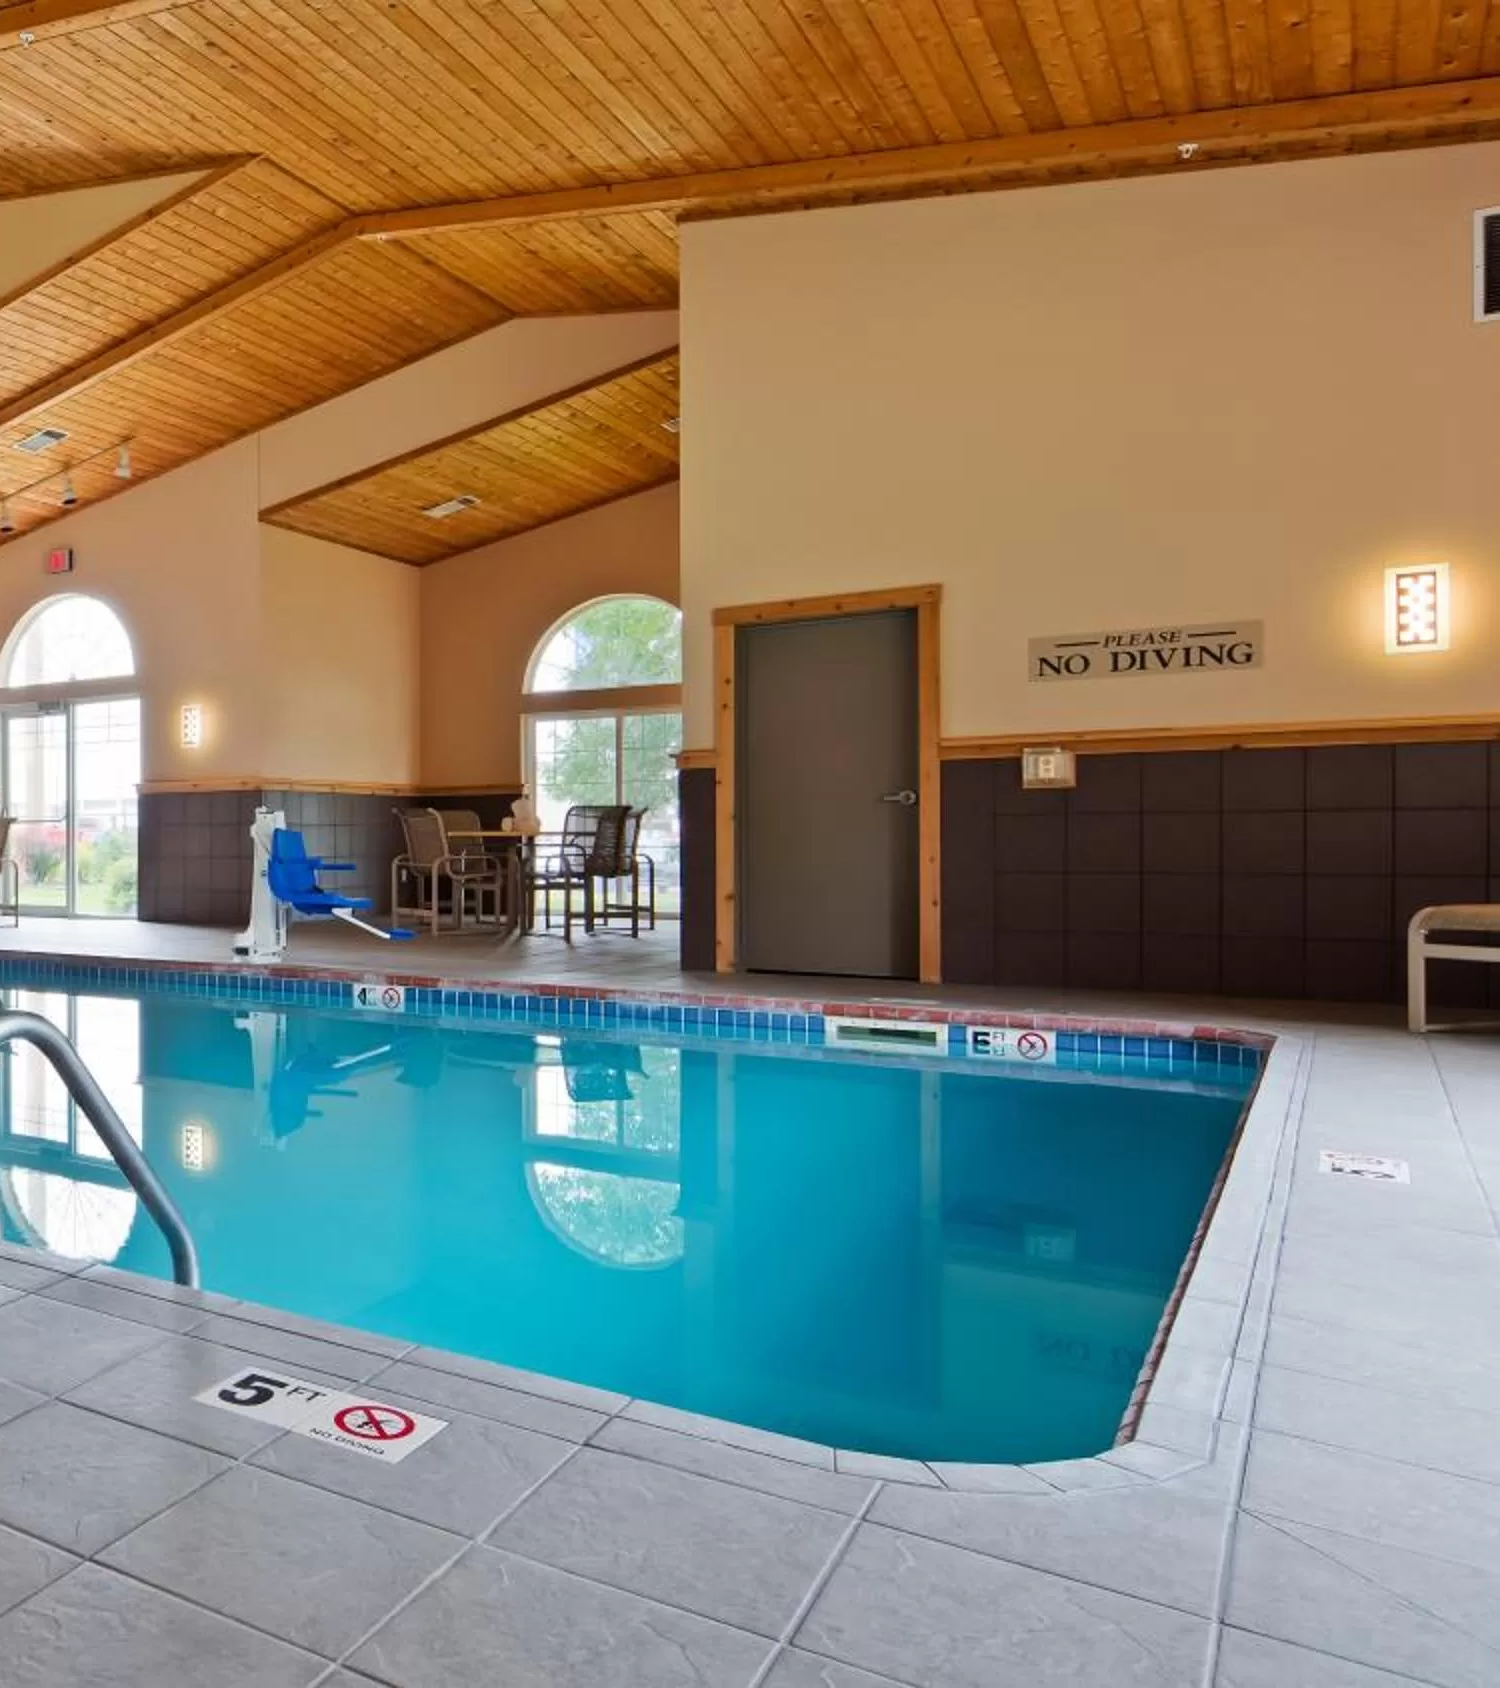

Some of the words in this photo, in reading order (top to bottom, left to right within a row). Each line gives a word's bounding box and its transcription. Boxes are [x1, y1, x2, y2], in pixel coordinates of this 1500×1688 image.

[1102, 630, 1182, 648] PLEASE
[1037, 653, 1091, 677] NO
[1109, 641, 1254, 672] DIVING
[218, 1373, 289, 1406] 5
[287, 1386, 328, 1402] FT
